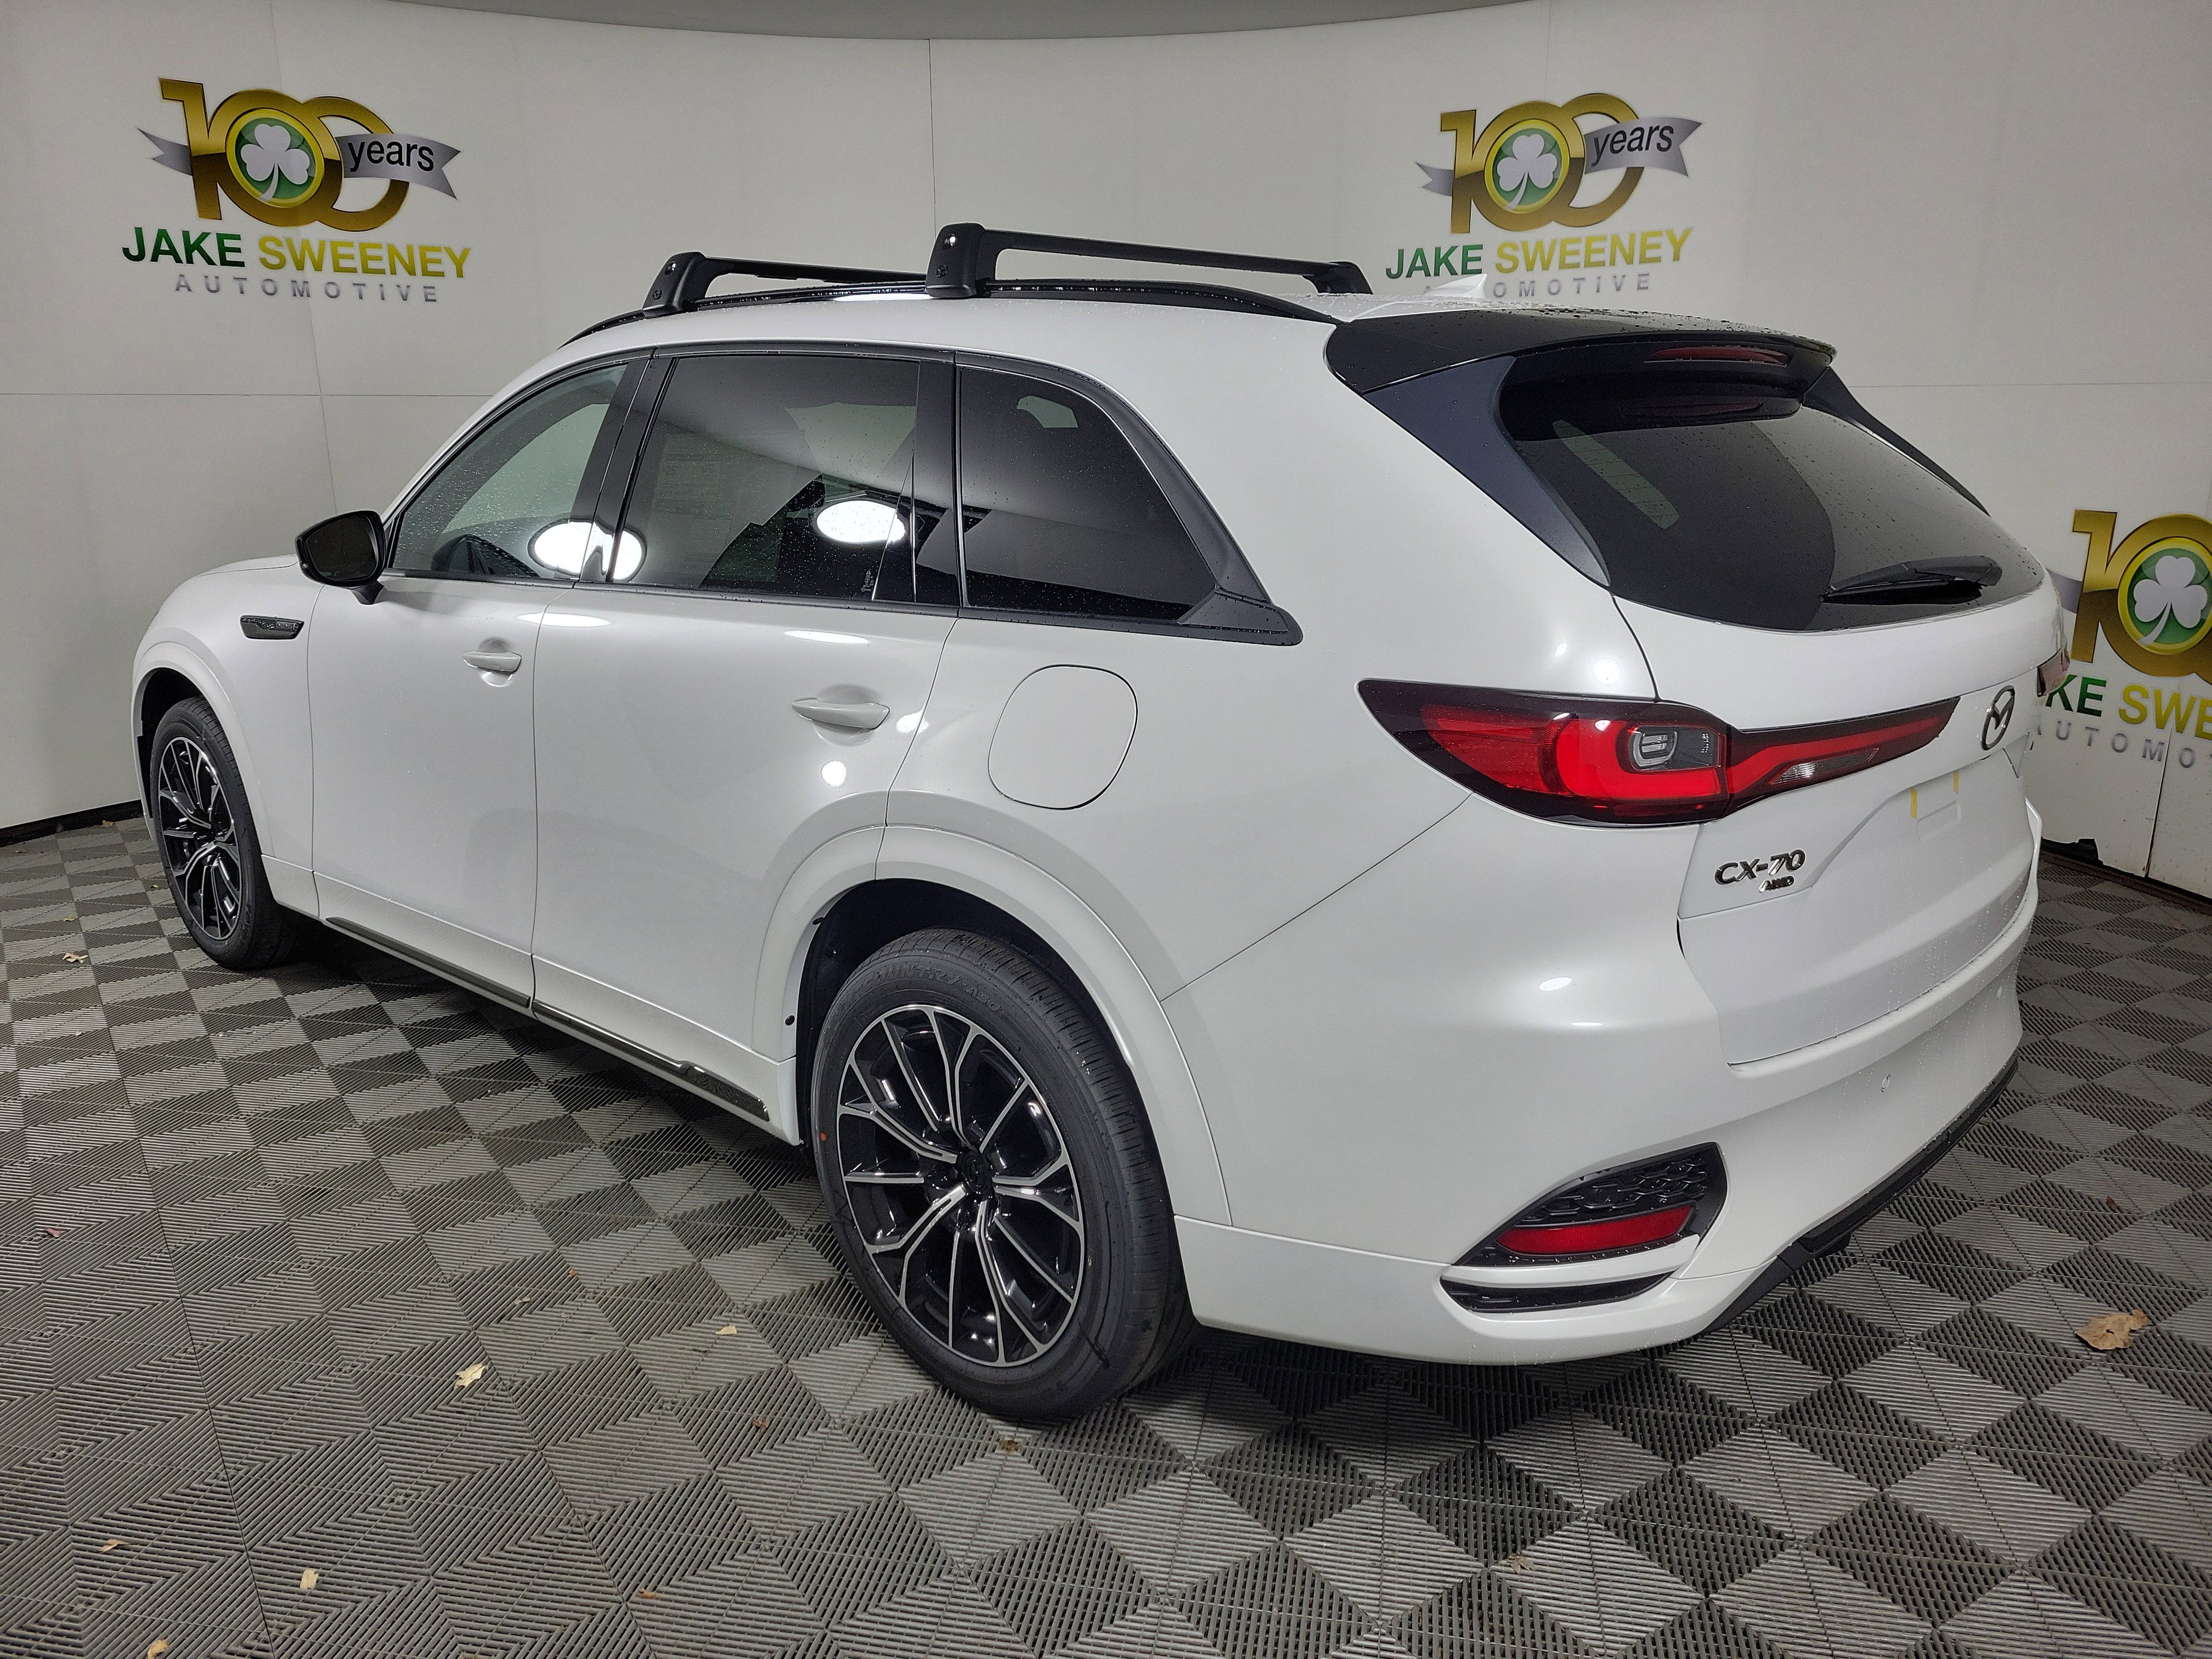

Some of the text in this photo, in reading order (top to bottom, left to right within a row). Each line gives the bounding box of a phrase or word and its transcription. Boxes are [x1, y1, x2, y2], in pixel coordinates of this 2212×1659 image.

[347, 139, 435, 172] years
[1592, 122, 1674, 167] years
[122, 226, 471, 278] JAKE SWEENEY
[1385, 228, 1694, 279] JAKE SWEENEY
[175, 274, 437, 302] AUTOMOTIVE
[1424, 273, 1650, 298] OMOTIVE
[1714, 849, 1805, 884] CX-70
